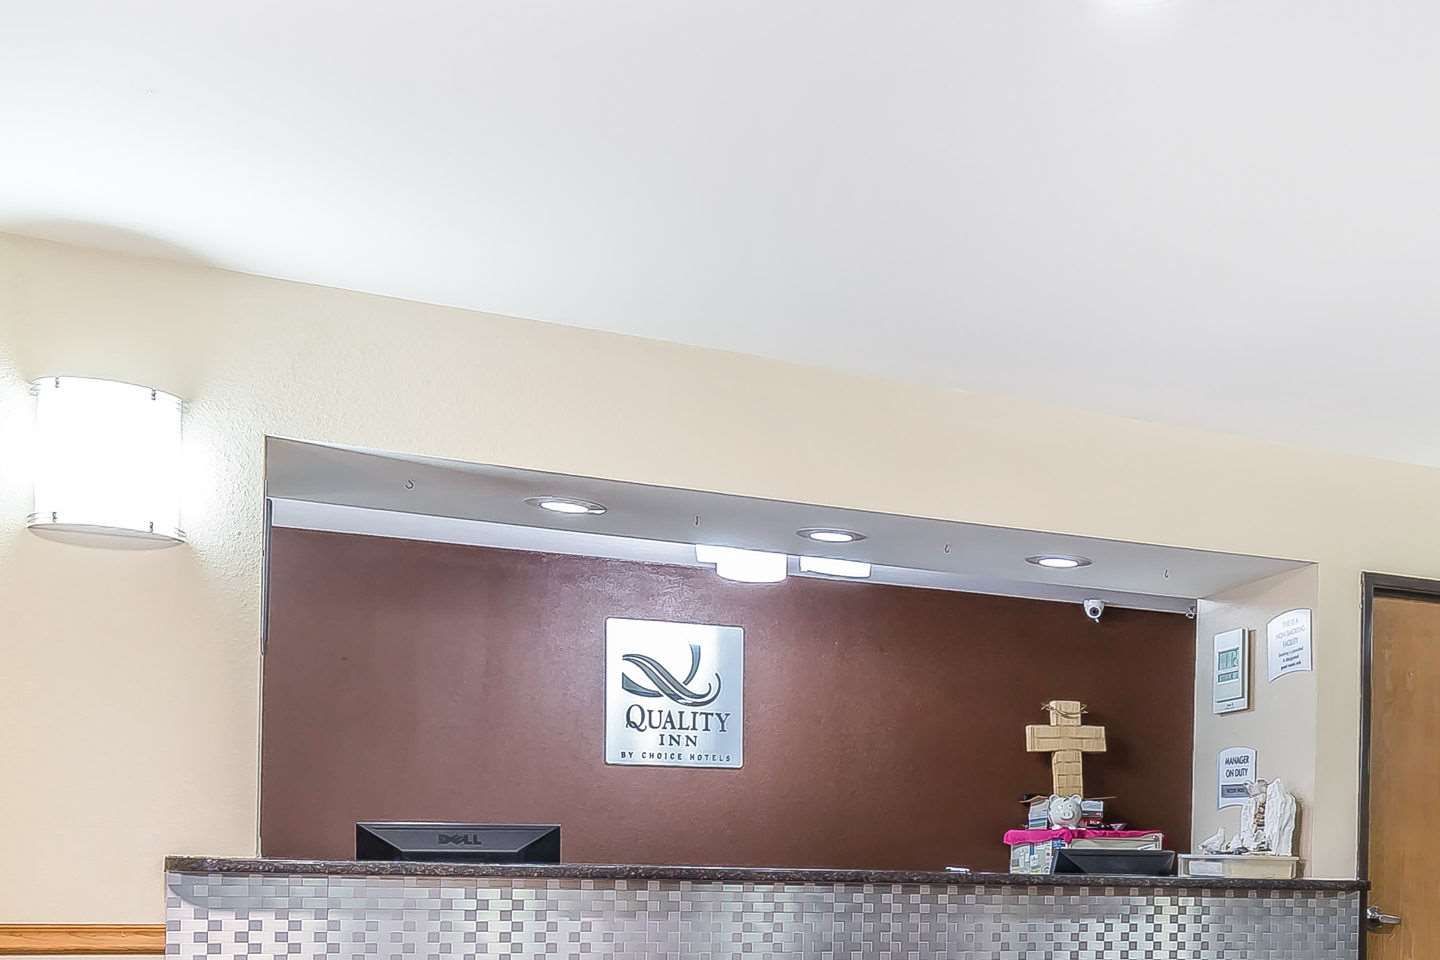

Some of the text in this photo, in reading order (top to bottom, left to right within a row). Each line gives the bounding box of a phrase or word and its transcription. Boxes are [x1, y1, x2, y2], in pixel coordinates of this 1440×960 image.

[625, 704, 731, 733] QUALITY
[659, 734, 698, 747] INN
[620, 751, 731, 762] BY CHOICE HOTELS
[1225, 755, 1249, 765] MANAGER
[1225, 768, 1249, 778] ON DUTY
[438, 834, 482, 845] DELL
